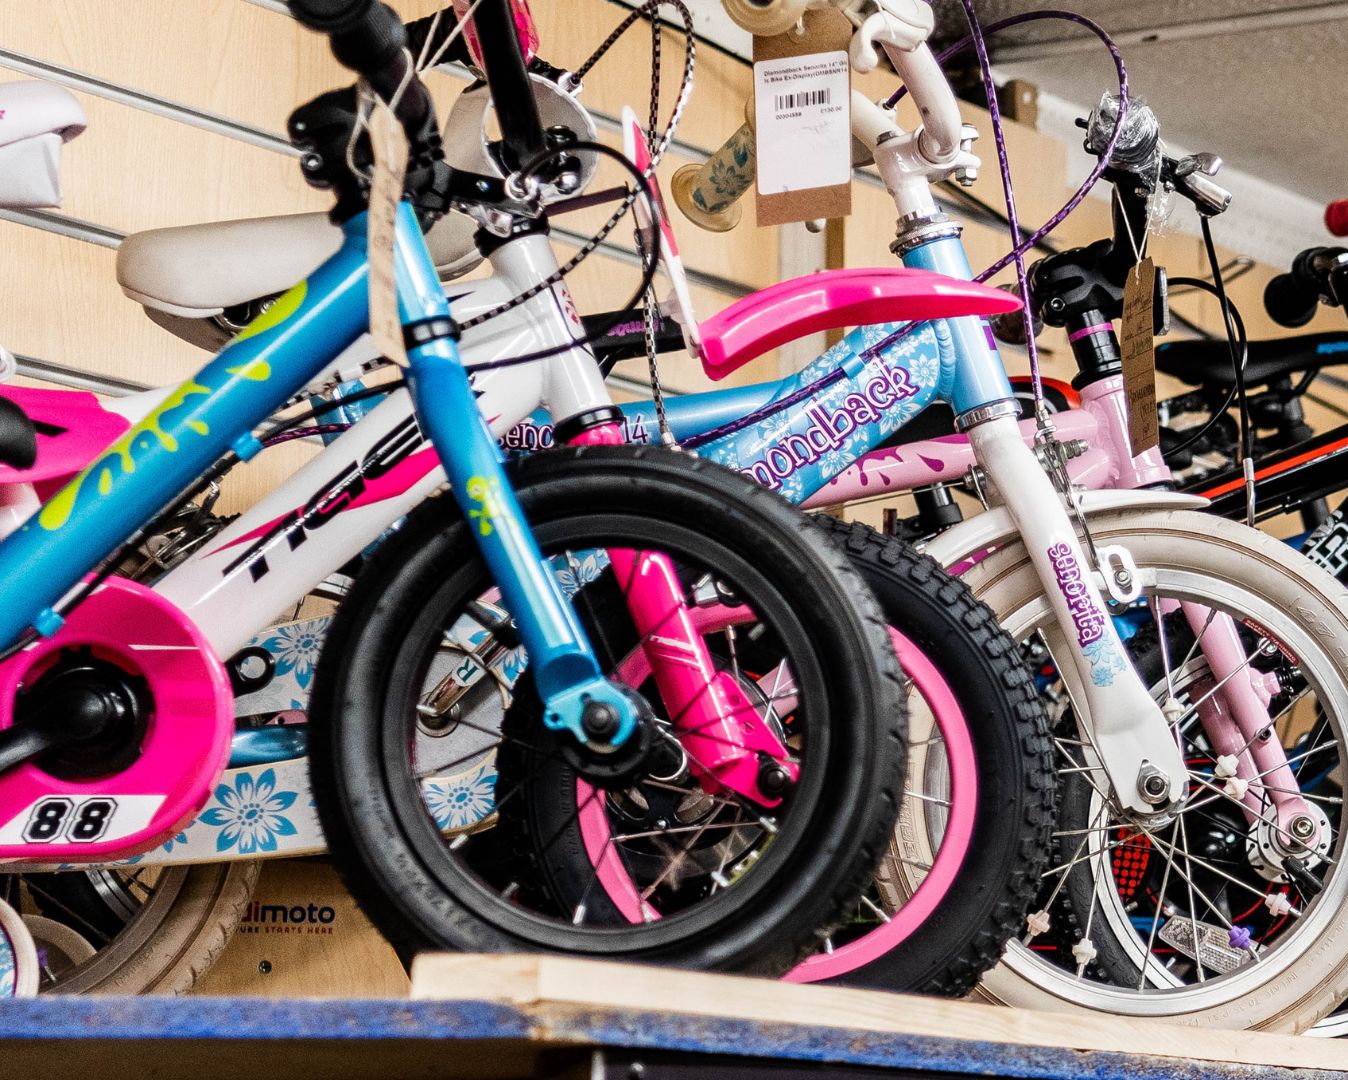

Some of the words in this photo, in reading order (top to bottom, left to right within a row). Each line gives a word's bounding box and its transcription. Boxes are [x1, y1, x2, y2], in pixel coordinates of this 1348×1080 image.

[764, 67, 802, 77] Diamondback
[740, 357, 920, 490] mondback
[222, 412, 425, 583] TIGE
[456, 657, 480, 682] R
[22, 797, 118, 844] 88
[241, 901, 336, 924] imoto
[264, 926, 303, 935] STARTS
[307, 926, 334, 935] HERE
